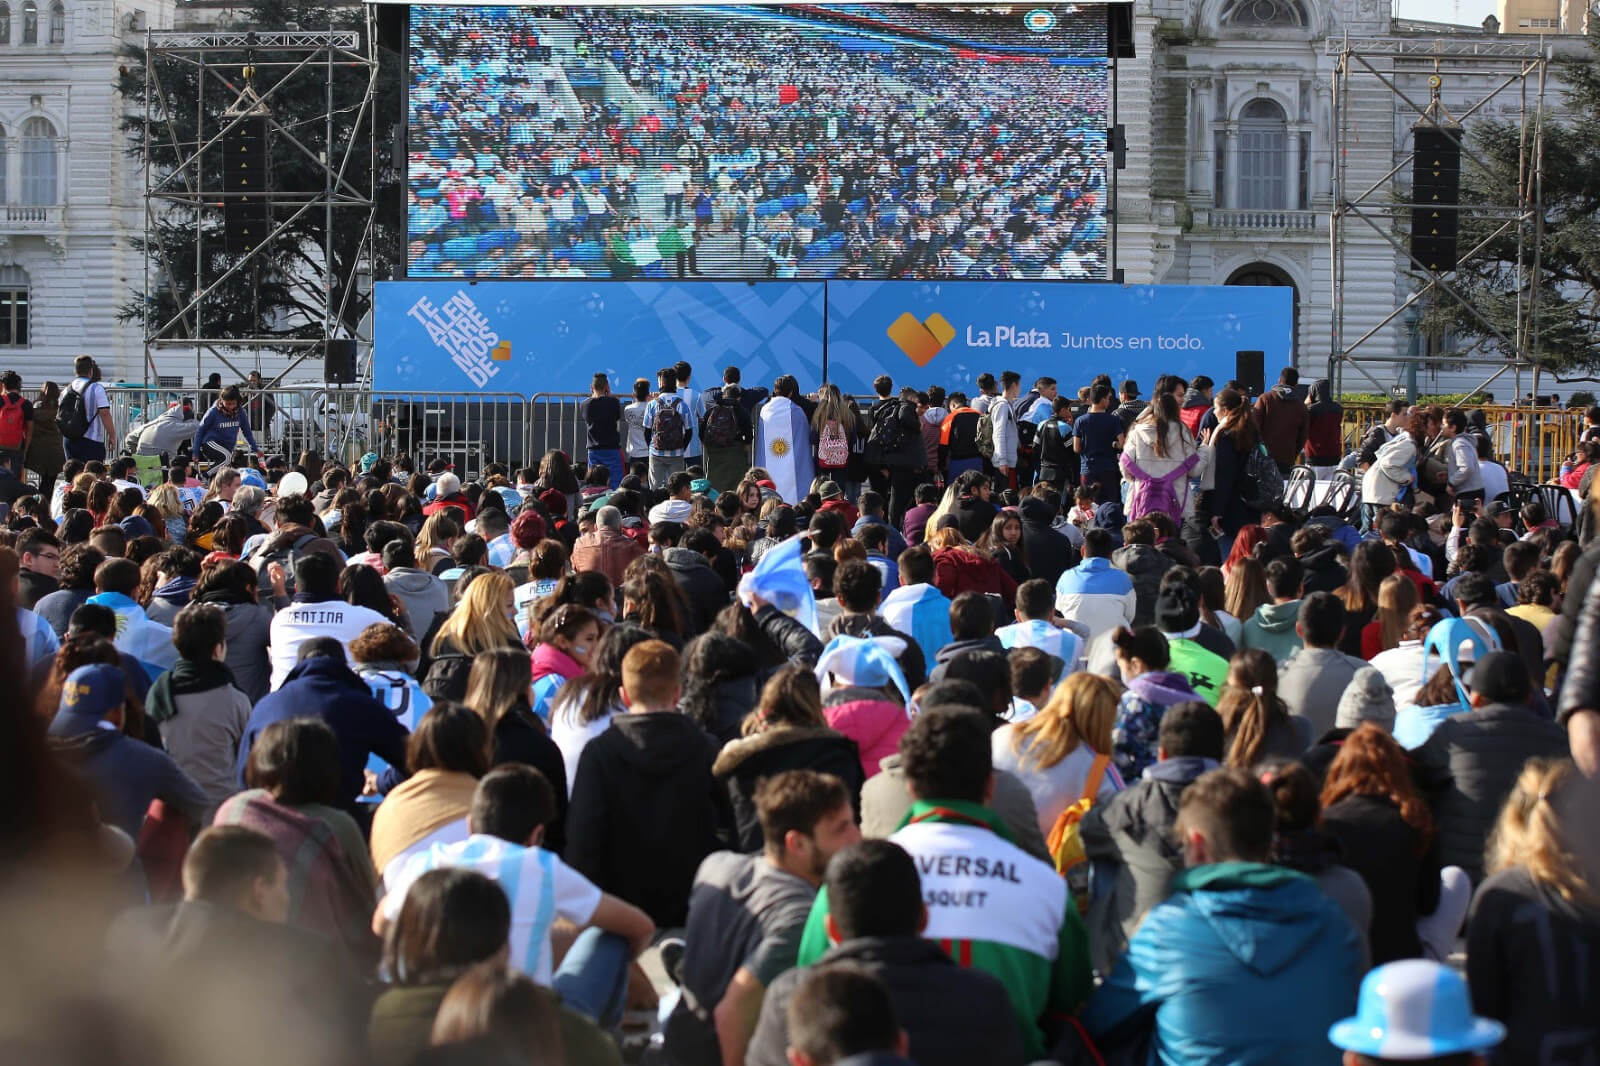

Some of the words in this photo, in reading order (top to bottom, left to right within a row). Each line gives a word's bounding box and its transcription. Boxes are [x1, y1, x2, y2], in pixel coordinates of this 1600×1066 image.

[407, 295, 439, 325] TE
[425, 289, 475, 343] ALEN
[436, 306, 489, 356] TARE
[966, 325, 992, 348] La
[995, 325, 1051, 348] Plata
[1060, 332, 1123, 350] Juntos
[1128, 336, 1152, 350] en
[1157, 333, 1205, 350] todo.
[452, 326, 499, 373] MOS
[467, 355, 500, 389] DE
[529, 583, 556, 595] MESSI
[919, 855, 1021, 884] VERSAL
[926, 889, 989, 907] SQUET
